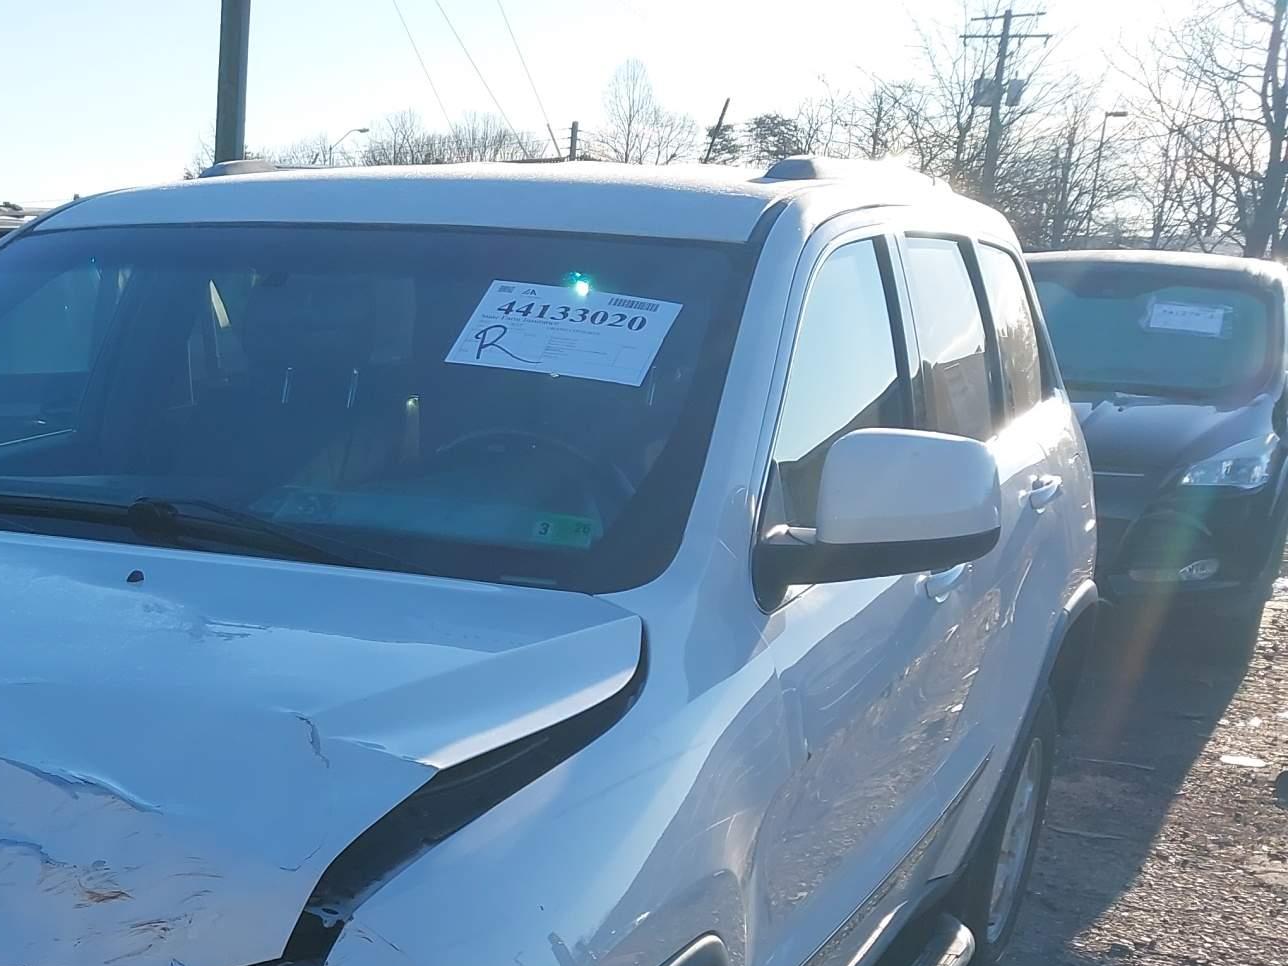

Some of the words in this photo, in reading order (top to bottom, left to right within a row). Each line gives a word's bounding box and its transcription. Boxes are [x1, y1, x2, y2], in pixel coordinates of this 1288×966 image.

[497, 299, 648, 332] 44133020
[474, 324, 543, 364] R
[538, 522, 550, 536] 3
